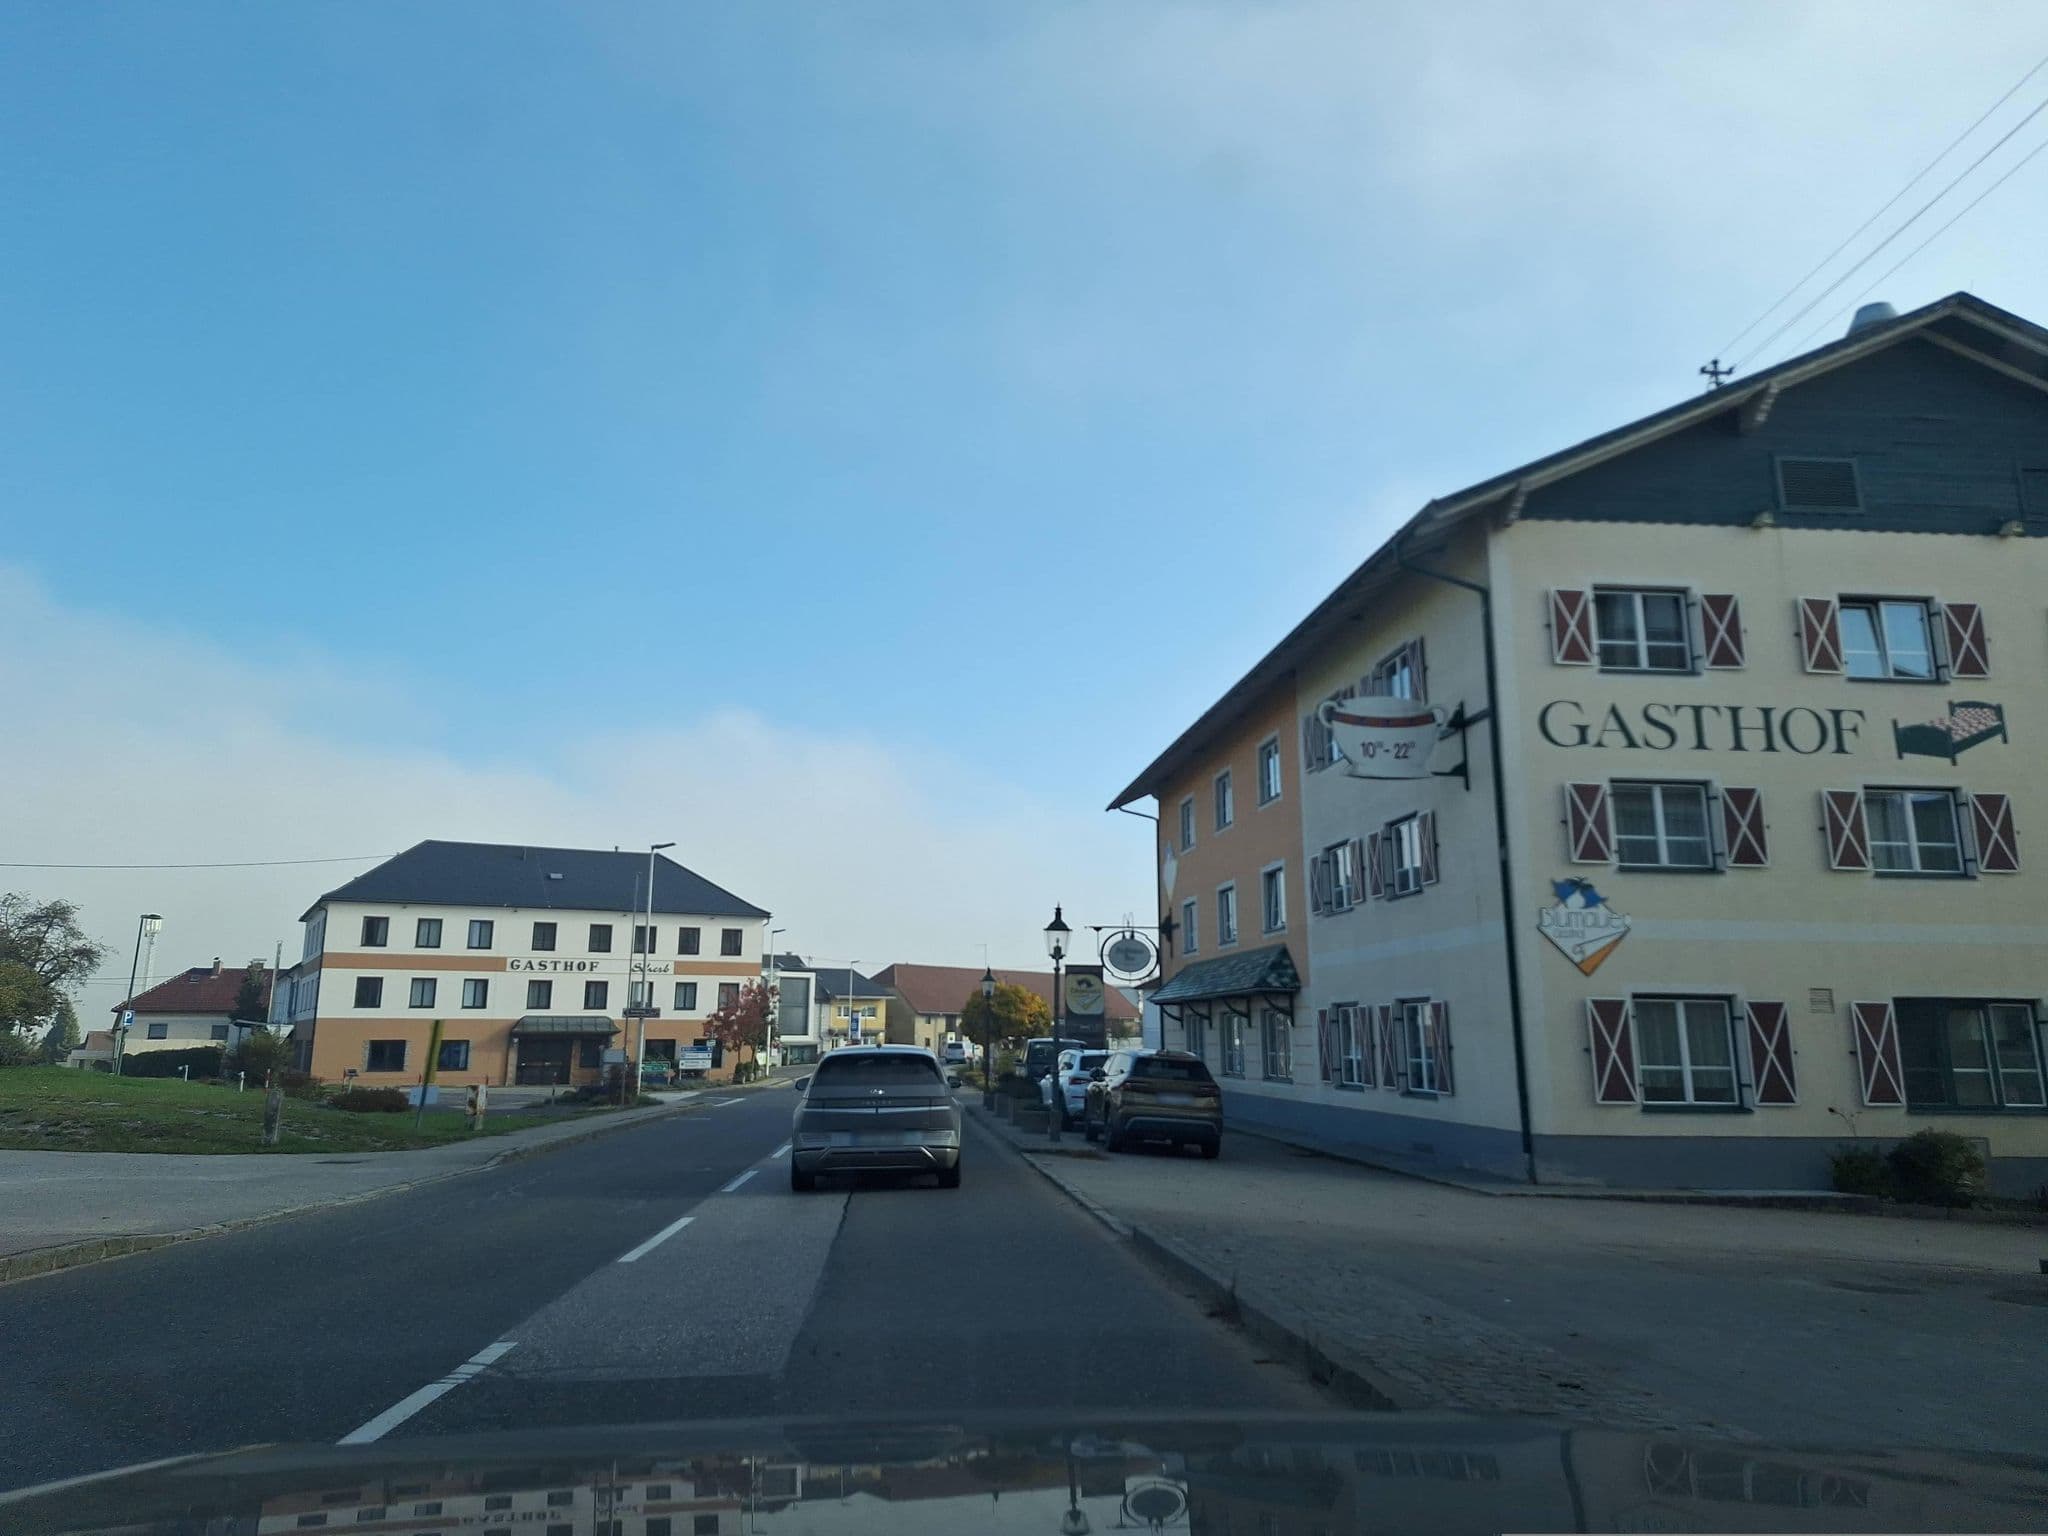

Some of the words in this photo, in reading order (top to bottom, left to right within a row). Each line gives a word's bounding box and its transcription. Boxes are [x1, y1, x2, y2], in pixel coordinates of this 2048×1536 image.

[1537, 700, 1867, 755] GASTHOF
[510, 958, 600, 972] GASTHOF
[124, 1011, 132, 1022] P
